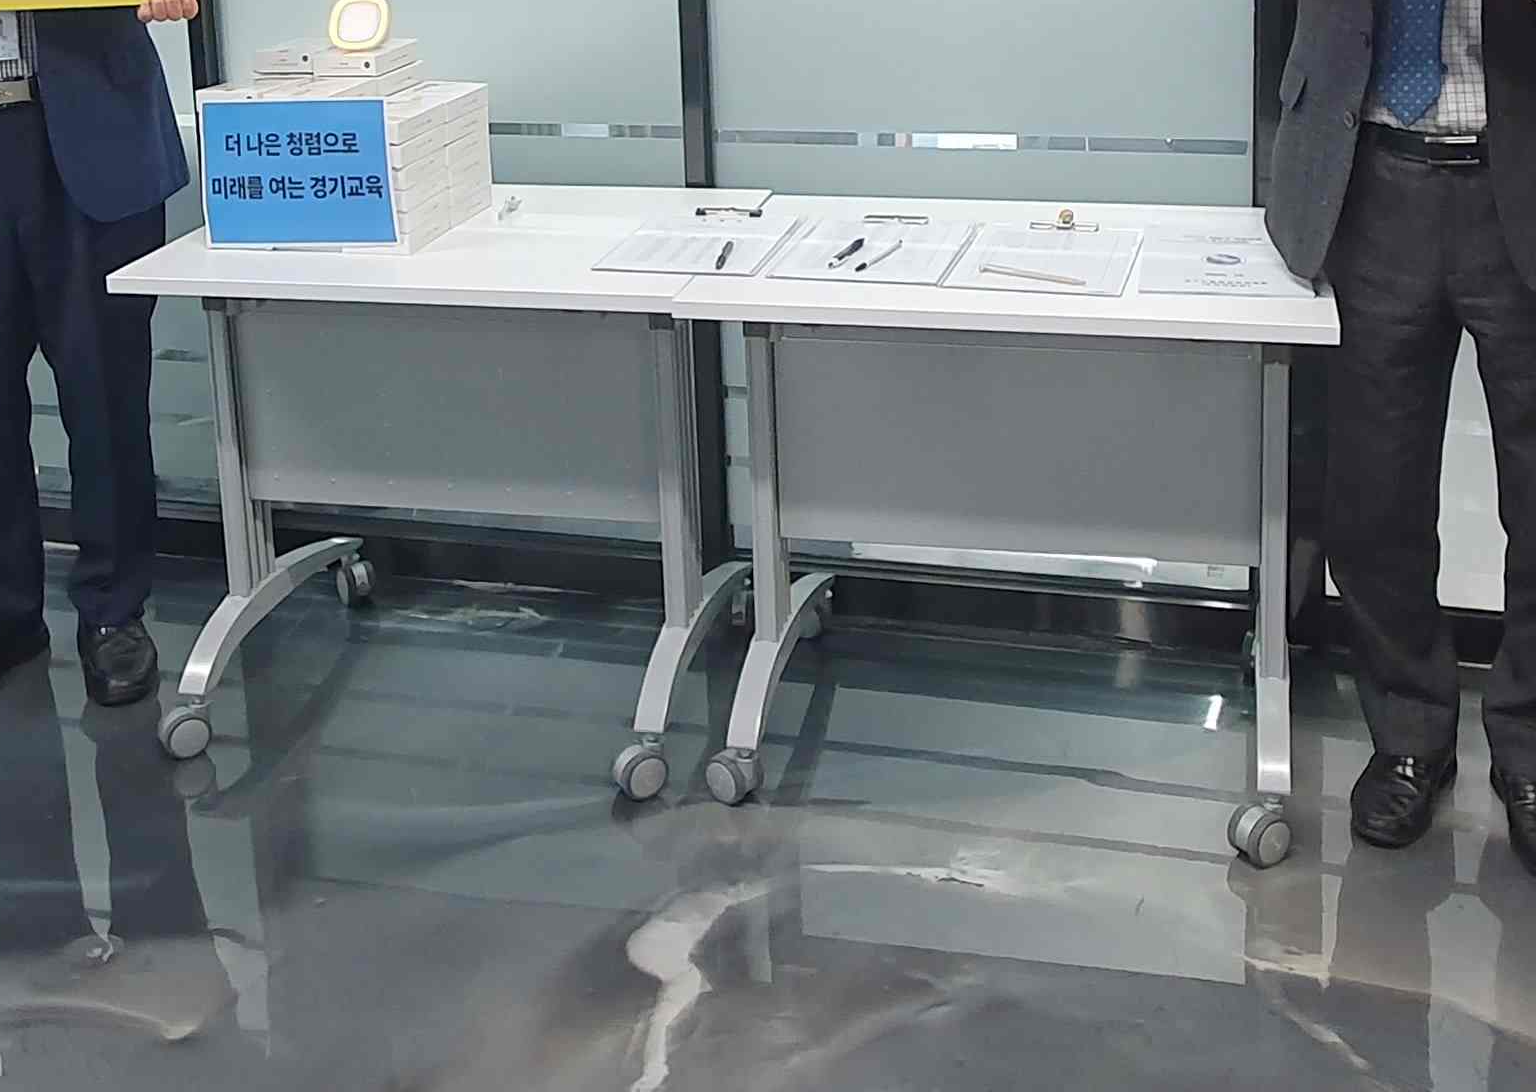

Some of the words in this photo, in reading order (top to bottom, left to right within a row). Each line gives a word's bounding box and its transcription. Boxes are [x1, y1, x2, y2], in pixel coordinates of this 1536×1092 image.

[224, 133, 242, 157] 더
[246, 132, 281, 157] 나은
[286, 132, 360, 157] 청렴으로
[211, 175, 264, 200] 미래를
[268, 175, 306, 200] 여는
[310, 175, 384, 200] 경기교육
